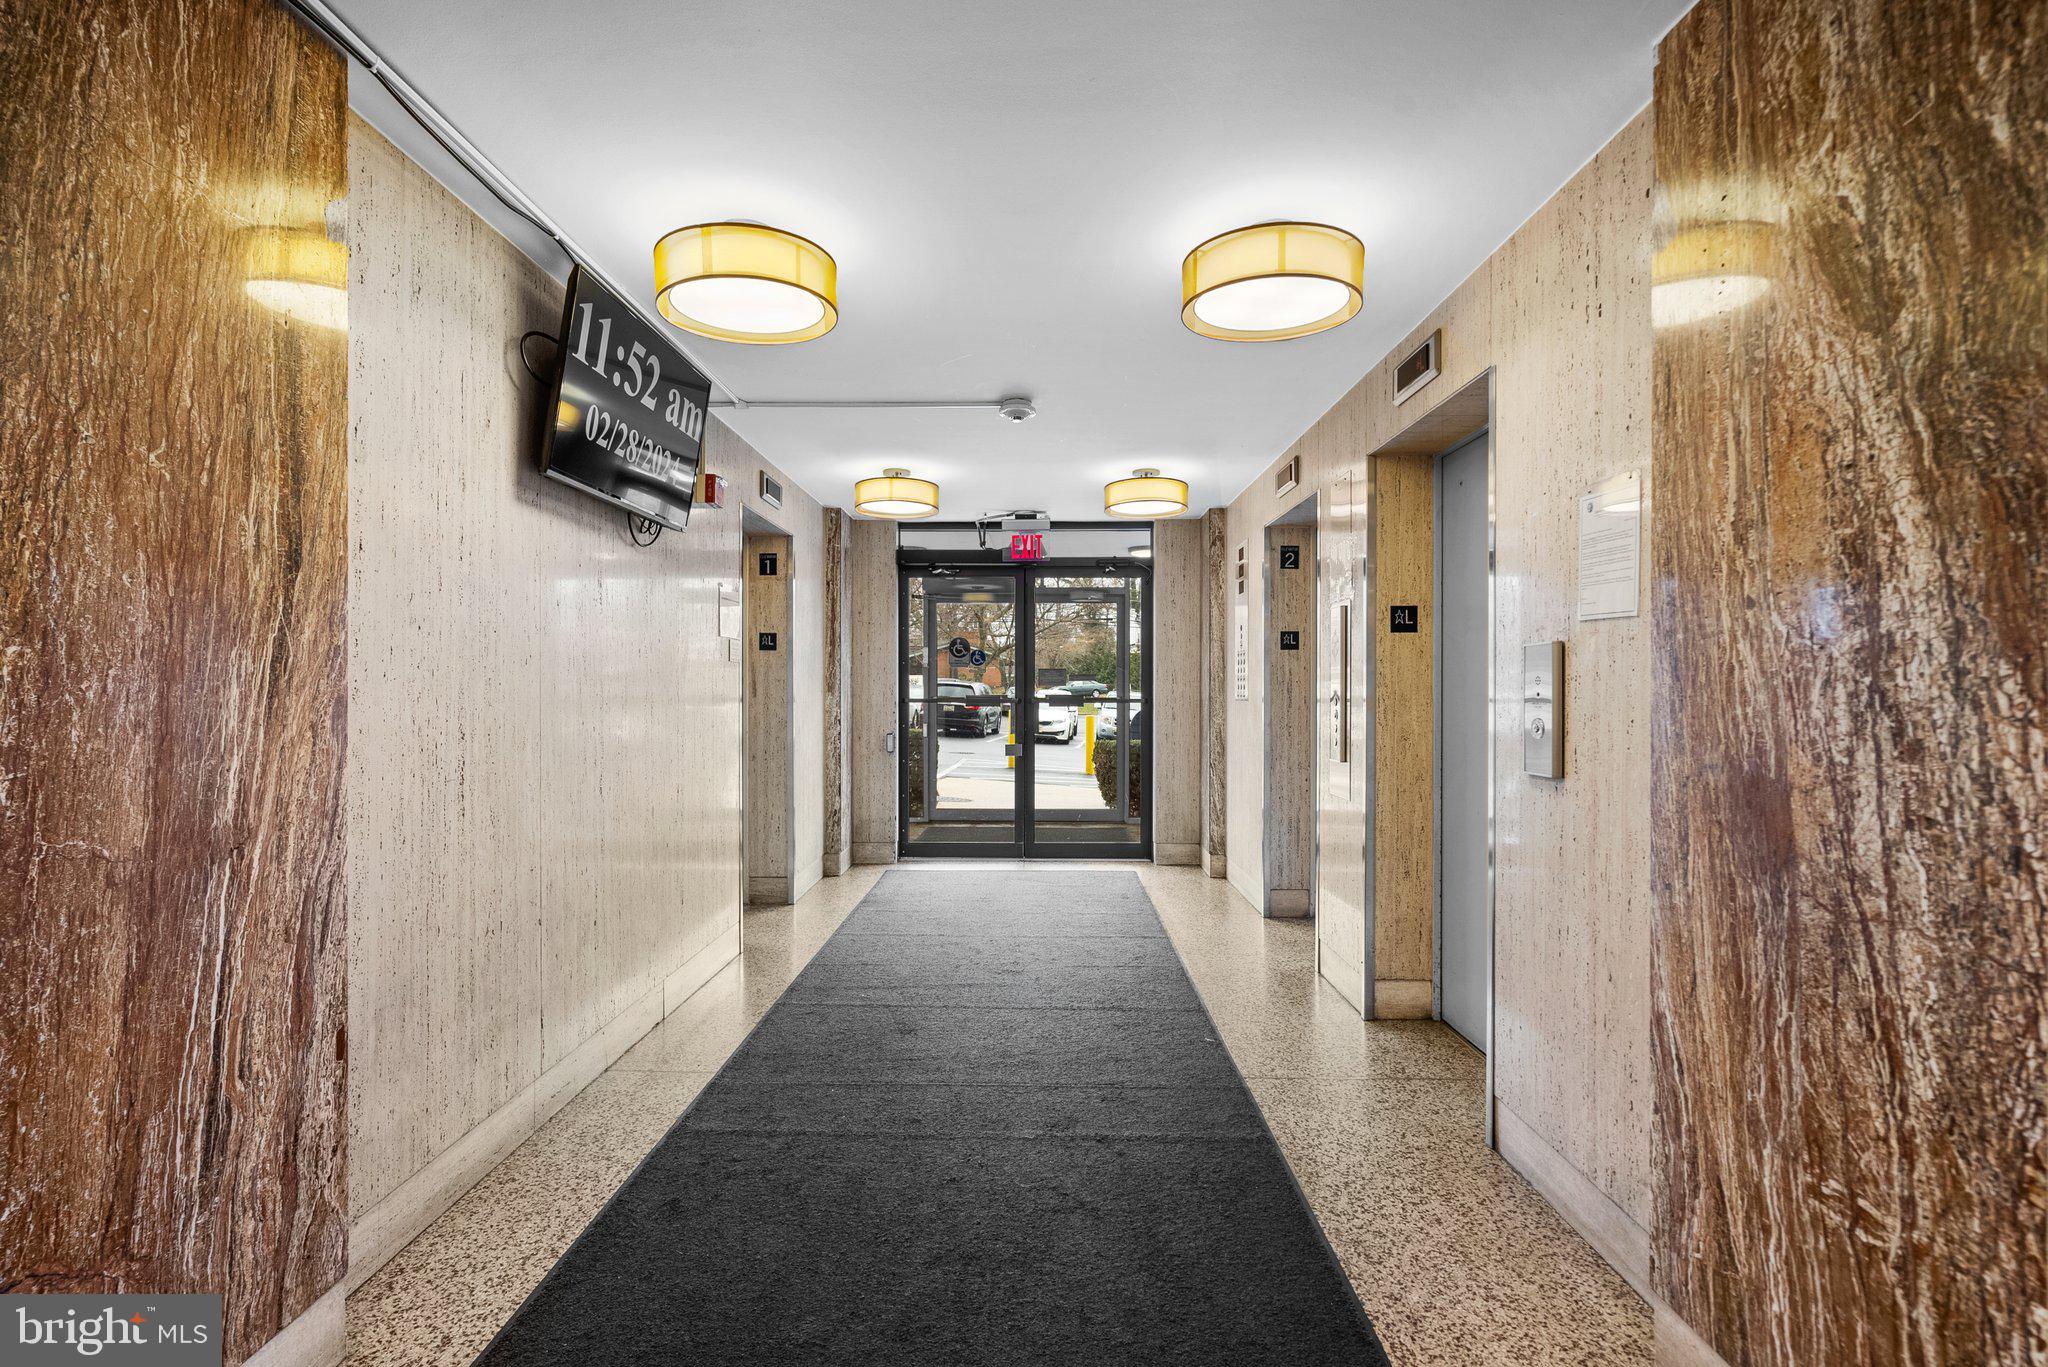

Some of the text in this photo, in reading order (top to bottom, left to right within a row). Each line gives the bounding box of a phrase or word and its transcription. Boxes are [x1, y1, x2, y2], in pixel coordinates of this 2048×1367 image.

[572, 302, 703, 443] 11:52 am
[1011, 534, 1043, 559] EXIT
[764, 559, 770, 574] 1
[1285, 552, 1295, 568] 2
